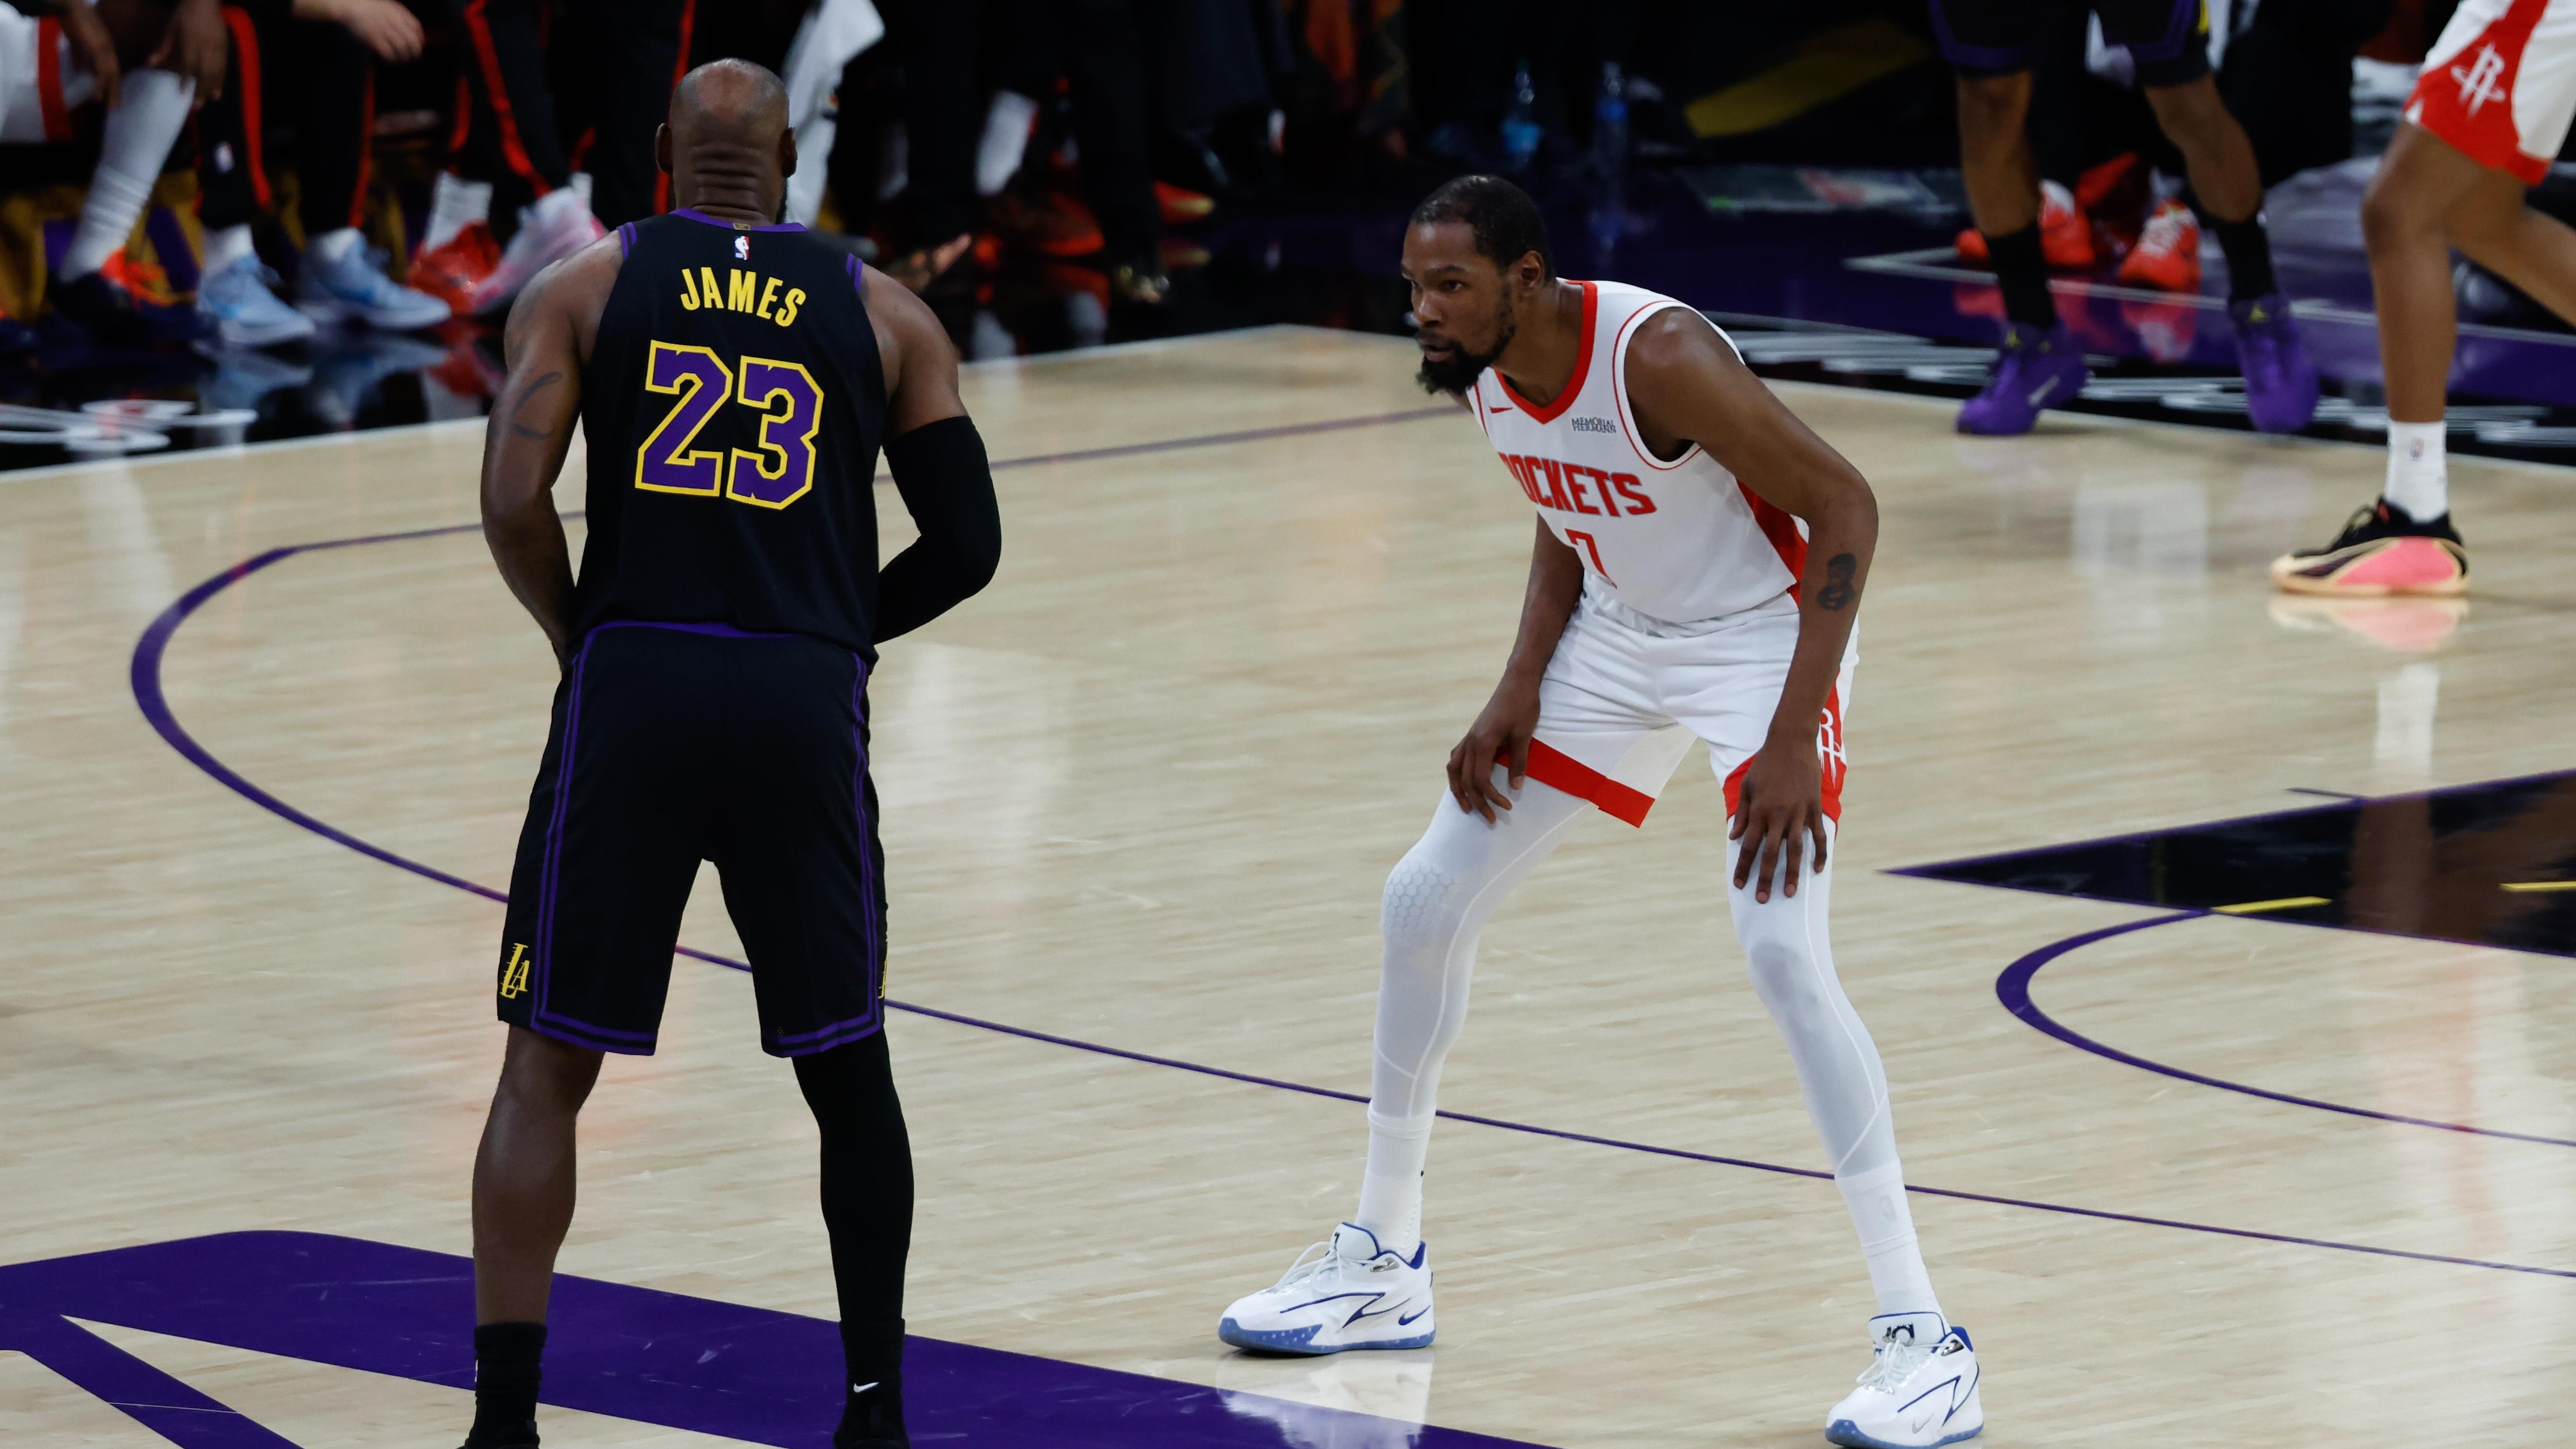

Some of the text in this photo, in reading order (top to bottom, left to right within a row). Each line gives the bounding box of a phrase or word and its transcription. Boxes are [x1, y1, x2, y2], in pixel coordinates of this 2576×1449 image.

[680, 267, 806, 327] JAMES
[635, 340, 824, 510] 23
[1565, 528, 1617, 588] 7
[500, 942, 530, 999] LA
